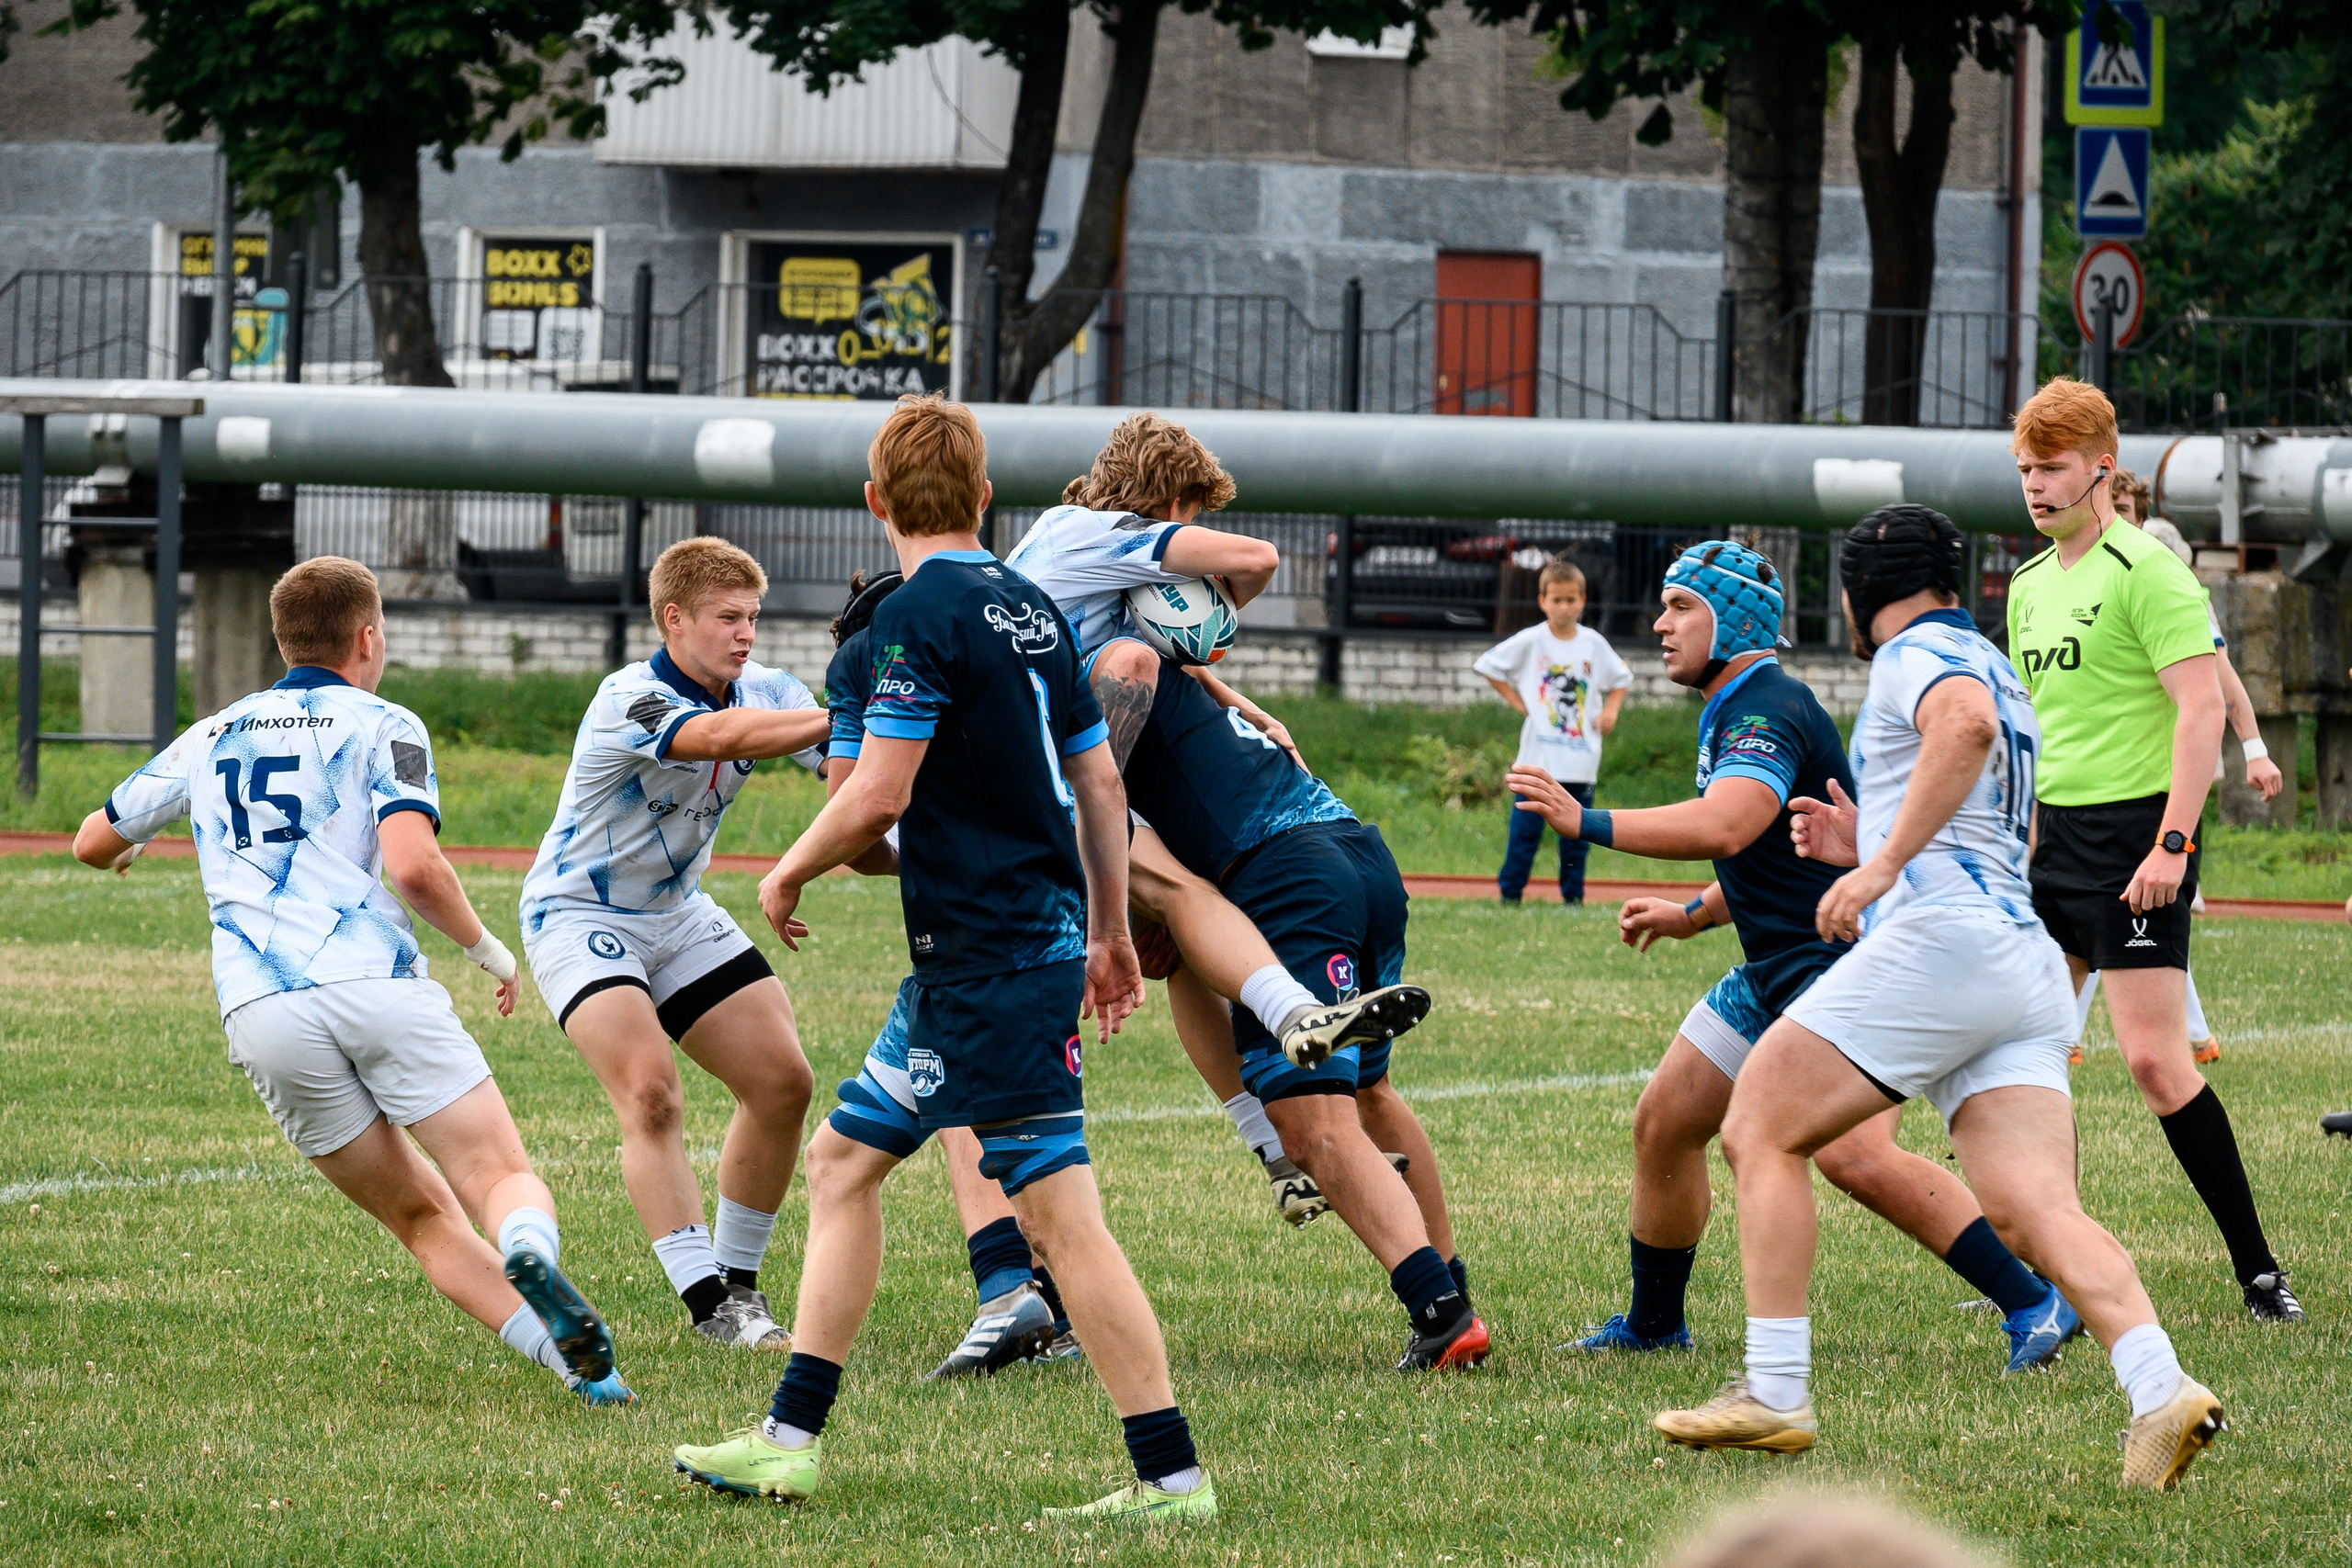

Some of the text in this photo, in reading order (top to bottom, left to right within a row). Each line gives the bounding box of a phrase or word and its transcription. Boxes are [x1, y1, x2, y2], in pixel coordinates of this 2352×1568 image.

[486, 249, 561, 276] BOXX
[2090, 274, 2130, 316] 30
[757, 333, 836, 362] BOXX
[876, 679, 916, 695] ПРО
[239, 716, 334, 732] Имхотеп
[1736, 738, 1777, 753] ПРО
[215, 754, 309, 851] 15
